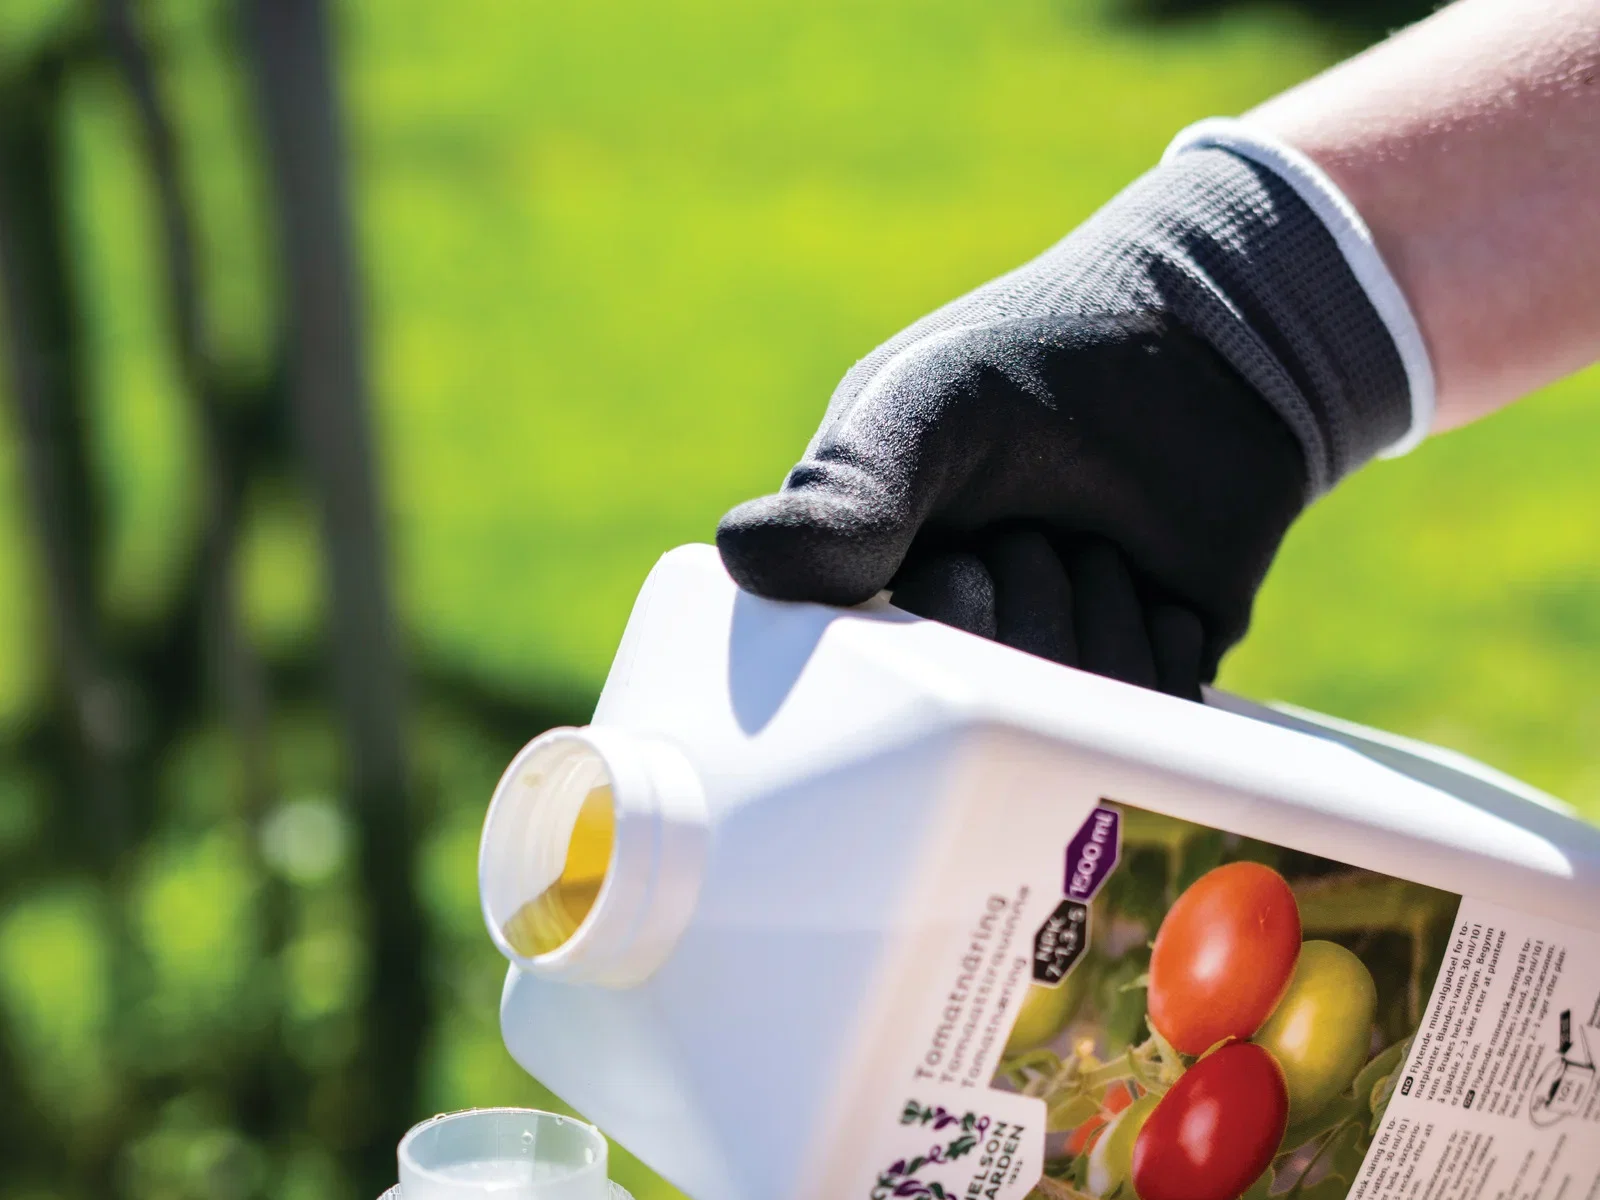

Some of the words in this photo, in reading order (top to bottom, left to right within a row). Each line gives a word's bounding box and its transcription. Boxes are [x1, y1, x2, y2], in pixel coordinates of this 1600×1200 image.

[1068, 843, 1104, 895] 1500
[1086, 811, 1116, 844] ml
[1034, 913, 1067, 962] NPK
[1464, 929, 1482, 958] ml/10
[1485, 930, 1510, 974] plantene
[1521, 937, 1533, 952] to-
[1461, 958, 1472, 971] 30
[1517, 953, 1528, 964] til
[1526, 945, 1544, 974] ml/10
[913, 894, 1008, 1082] Tomatnäring
[1451, 972, 1468, 999] vann,
[1482, 976, 1492, 987] at
[1505, 965, 1525, 999] næring
[1523, 975, 1533, 987] 30
[1543, 974, 1559, 997] efter
[1402, 1077, 1413, 1094] NO
[1410, 1031, 1434, 1074] Flytende
[1426, 956, 1462, 1030] mineralgjødsel
[1453, 939, 1465, 954] for
[1459, 920, 1471, 936] to-
[1426, 1074, 1443, 1101] vann.
[1437, 1040, 1456, 1073] Brukes
[1450, 1017, 1465, 1039] hele
[1459, 967, 1485, 1016] sesongen.
[1475, 927, 1498, 965] Begynn
[1472, 989, 1488, 1013] etter
[1498, 1042, 1521, 1088] Anvendes
[1517, 1016, 1531, 1037] hele
[1524, 943, 1558, 1015] vækstsæsonen.
[1512, 988, 1530, 1015] vand,
[1536, 999, 1551, 1021] uger
[1435, 1004, 1456, 1042] Blandes
[1463, 1015, 1478, 1037] uker
[1488, 1000, 1512, 1046] mineralsk
[1496, 1020, 1517, 1058] Blandes
[1469, 1041, 1482, 1060] om.
[1471, 1046, 1494, 1089] Flydende
[1414, 1042, 1443, 1099] matplanter.
[1442, 1060, 1462, 1096] gjødsle
[1454, 1060, 1475, 1095] plantet
[1508, 1043, 1534, 1093] gødningen
[1451, 1096, 1460, 1106] er
[1364, 1148, 1386, 1177] näring
[1379, 1132, 1391, 1146] för
[1387, 1116, 1399, 1130] to-
[1389, 1123, 1410, 1150] ml/10
[1384, 1151, 1396, 1163] 30
[1385, 1170, 1401, 1190] hela
[1395, 1121, 1426, 1168] växtperio-
[1396, 1164, 1417, 1193] veckor
[1410, 1139, 1428, 1162] efter
[1422, 1123, 1435, 1137] att
[1369, 1165, 1391, 1194] vatten,
